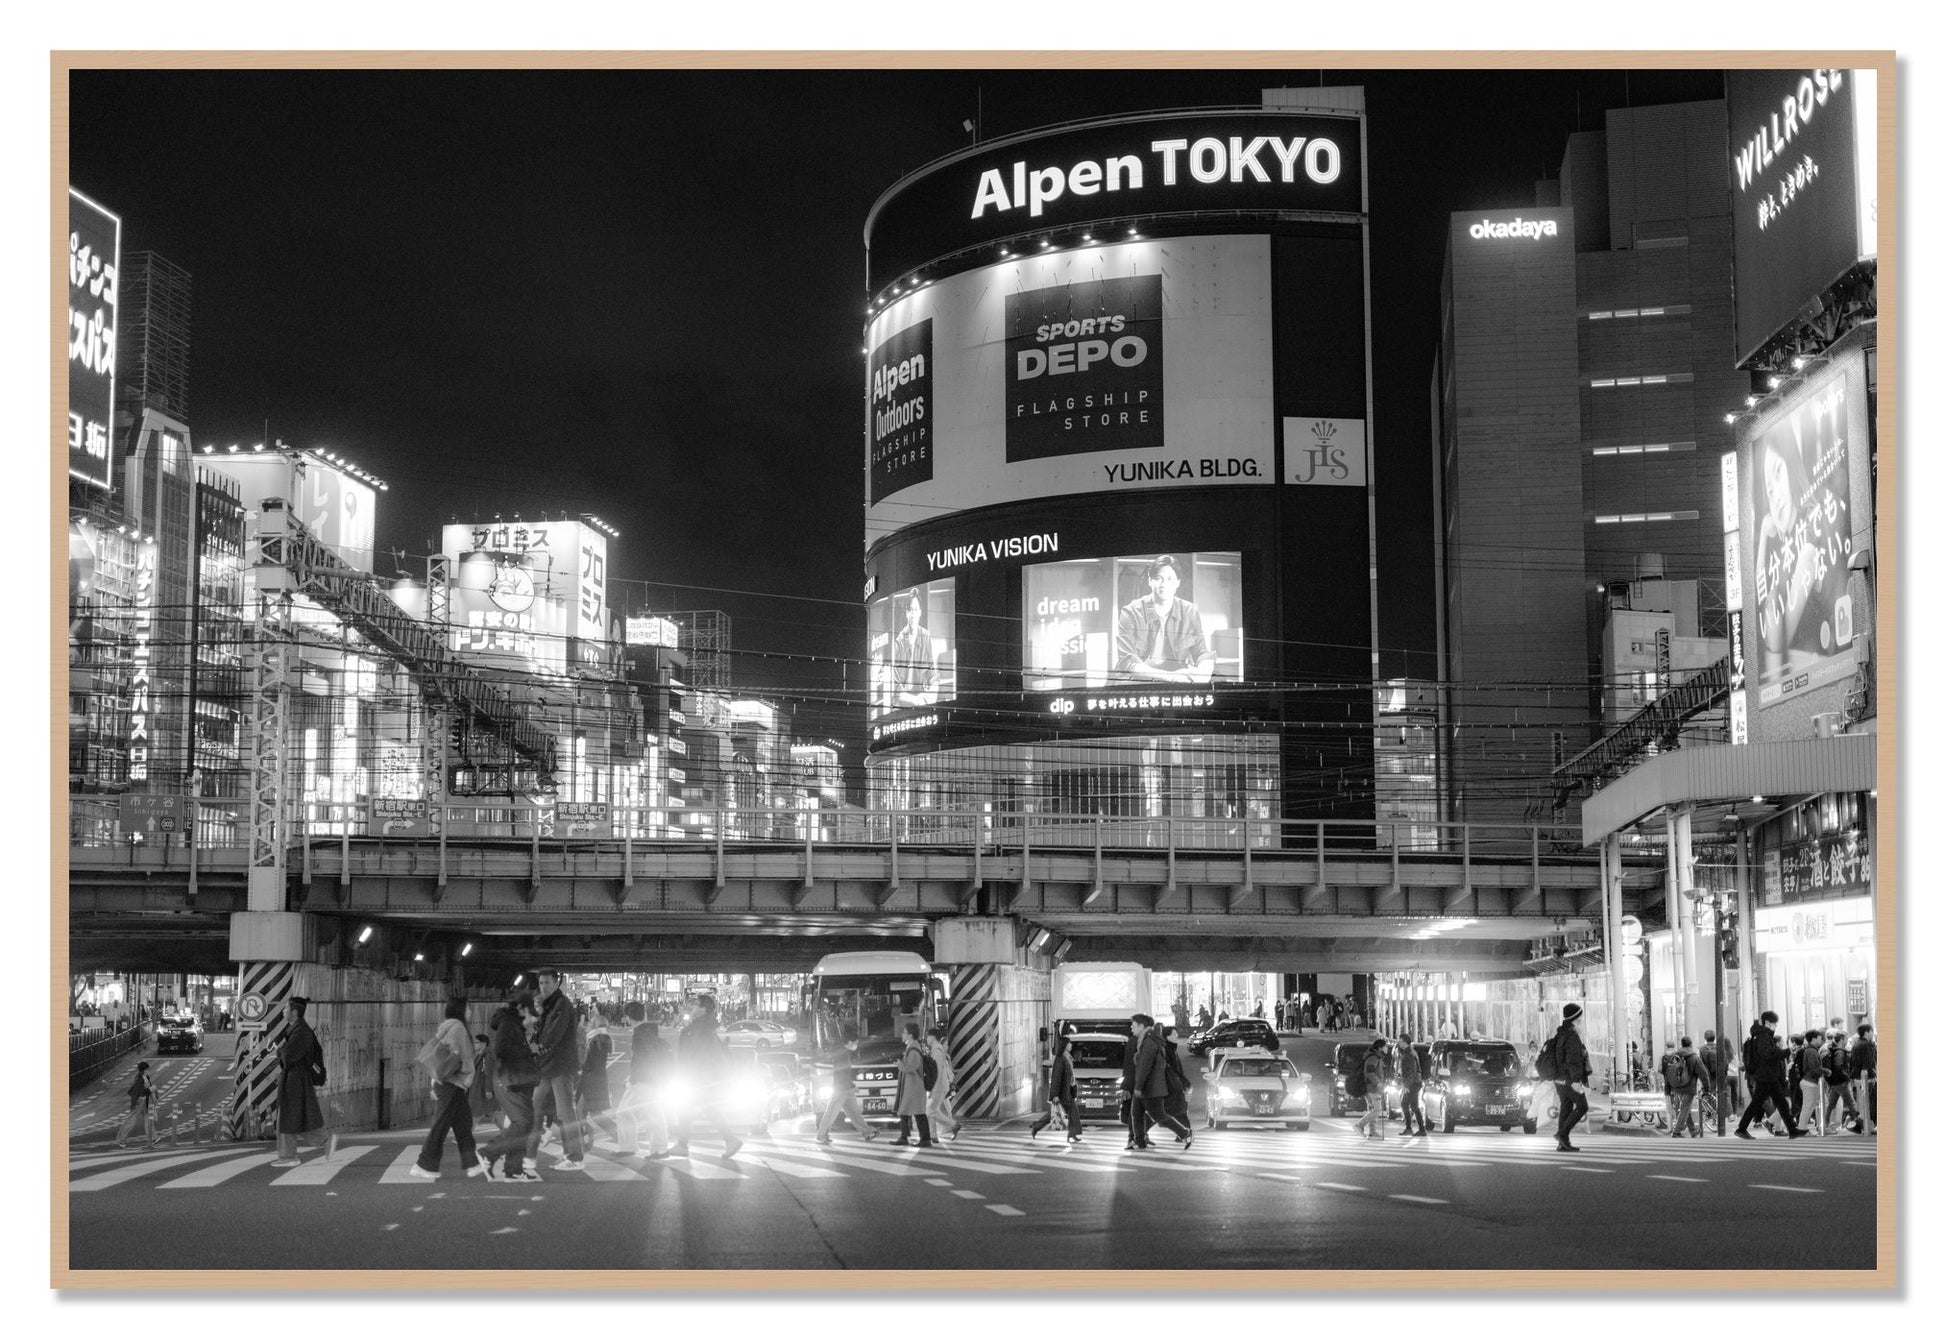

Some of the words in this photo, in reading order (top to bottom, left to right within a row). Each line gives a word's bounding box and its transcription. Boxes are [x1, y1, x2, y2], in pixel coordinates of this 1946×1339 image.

[1734, 69, 1843, 193] WILLROSE
[971, 153, 1143, 219] Alpen
[1151, 136, 1341, 186] TOKYO
[1469, 217, 1558, 241] okadaya
[1036, 314, 1126, 342] SPORTS
[1017, 335, 1148, 381] DEPO
[873, 353, 925, 405] Alpen
[1016, 390, 1149, 417] FLAGSHIP
[876, 396, 924, 441] Outdoors
[1064, 409, 1149, 431] STORE
[873, 427, 926, 466] FLAGSHIP
[887, 446, 926, 473] STORE
[1105, 460, 1194, 483] YUNIKA
[1199, 458, 1262, 479] BLDG.
[206, 533, 240, 556] SHISHA
[472, 527, 550, 549] プロミス
[1757, 488, 1846, 606] 自分本位でも、
[927, 543, 987, 572] YUNIKA
[990, 532, 1059, 560] VISION
[1759, 532, 1851, 639] いいじゃない。
[1037, 596, 1100, 616] dream
[1050, 698, 1075, 715] dip
[1087, 695, 1215, 711] 夢を叶える仕事に出会おう
[374, 799, 425, 812] 新宿駅東口
[557, 803, 606, 814] 新宿駅東口
